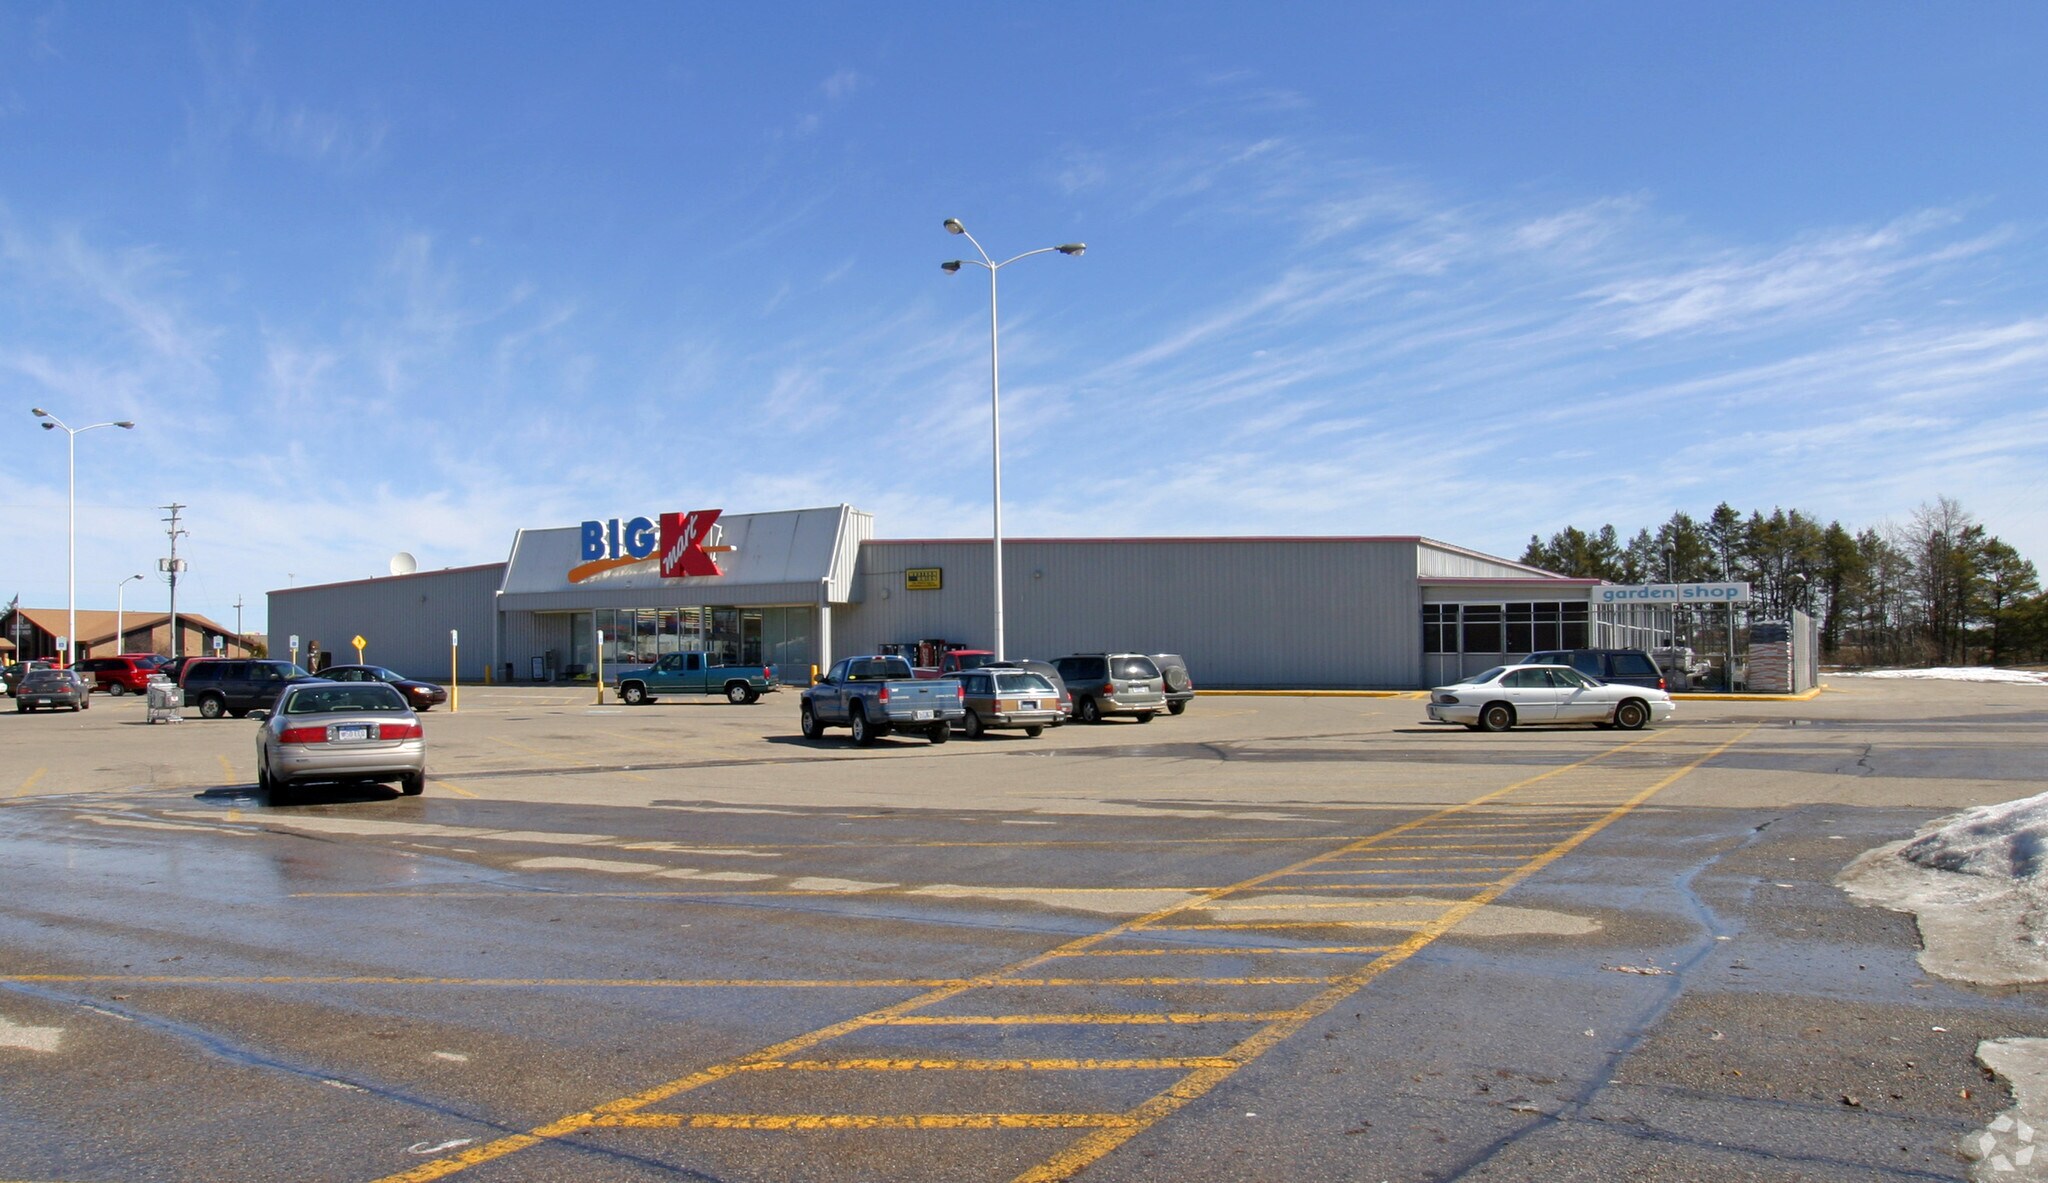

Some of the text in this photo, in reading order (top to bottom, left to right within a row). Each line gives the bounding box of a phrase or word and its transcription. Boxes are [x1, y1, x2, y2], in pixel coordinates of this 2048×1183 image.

[582, 509, 724, 578] BIG K
[662, 514, 698, 575] mart
[1603, 586, 1738, 602] garden shop
